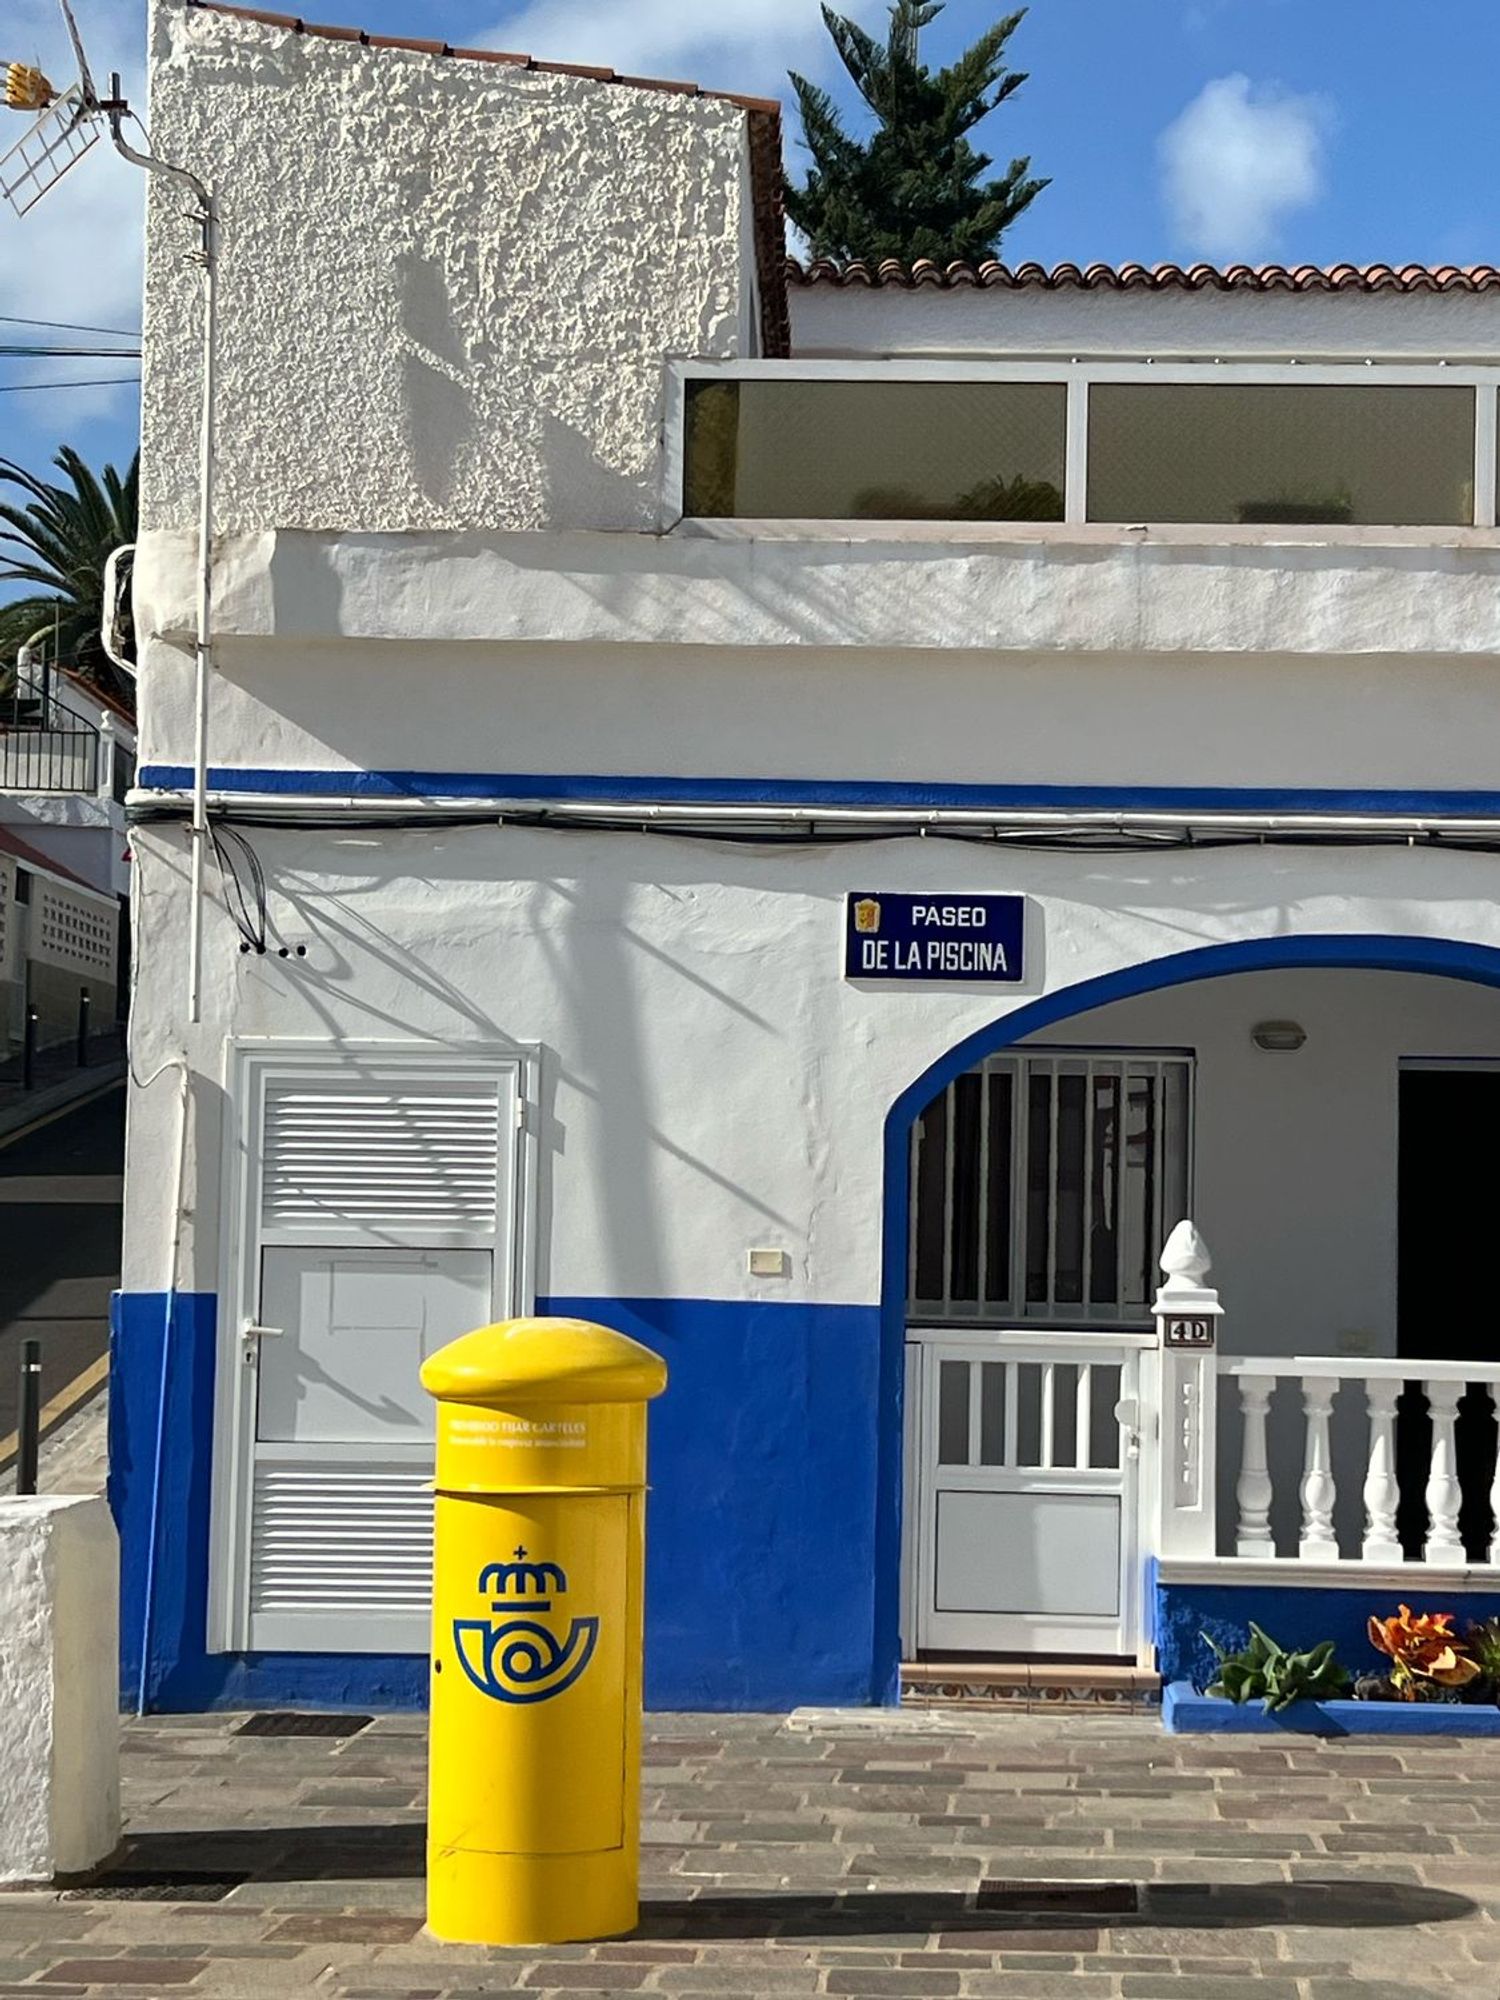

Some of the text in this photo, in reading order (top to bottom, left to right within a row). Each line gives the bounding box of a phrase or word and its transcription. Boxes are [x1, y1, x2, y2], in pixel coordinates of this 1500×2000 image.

[912, 906, 986, 926] PASEO
[862, 940, 1008, 972] DE LA PISCINA
